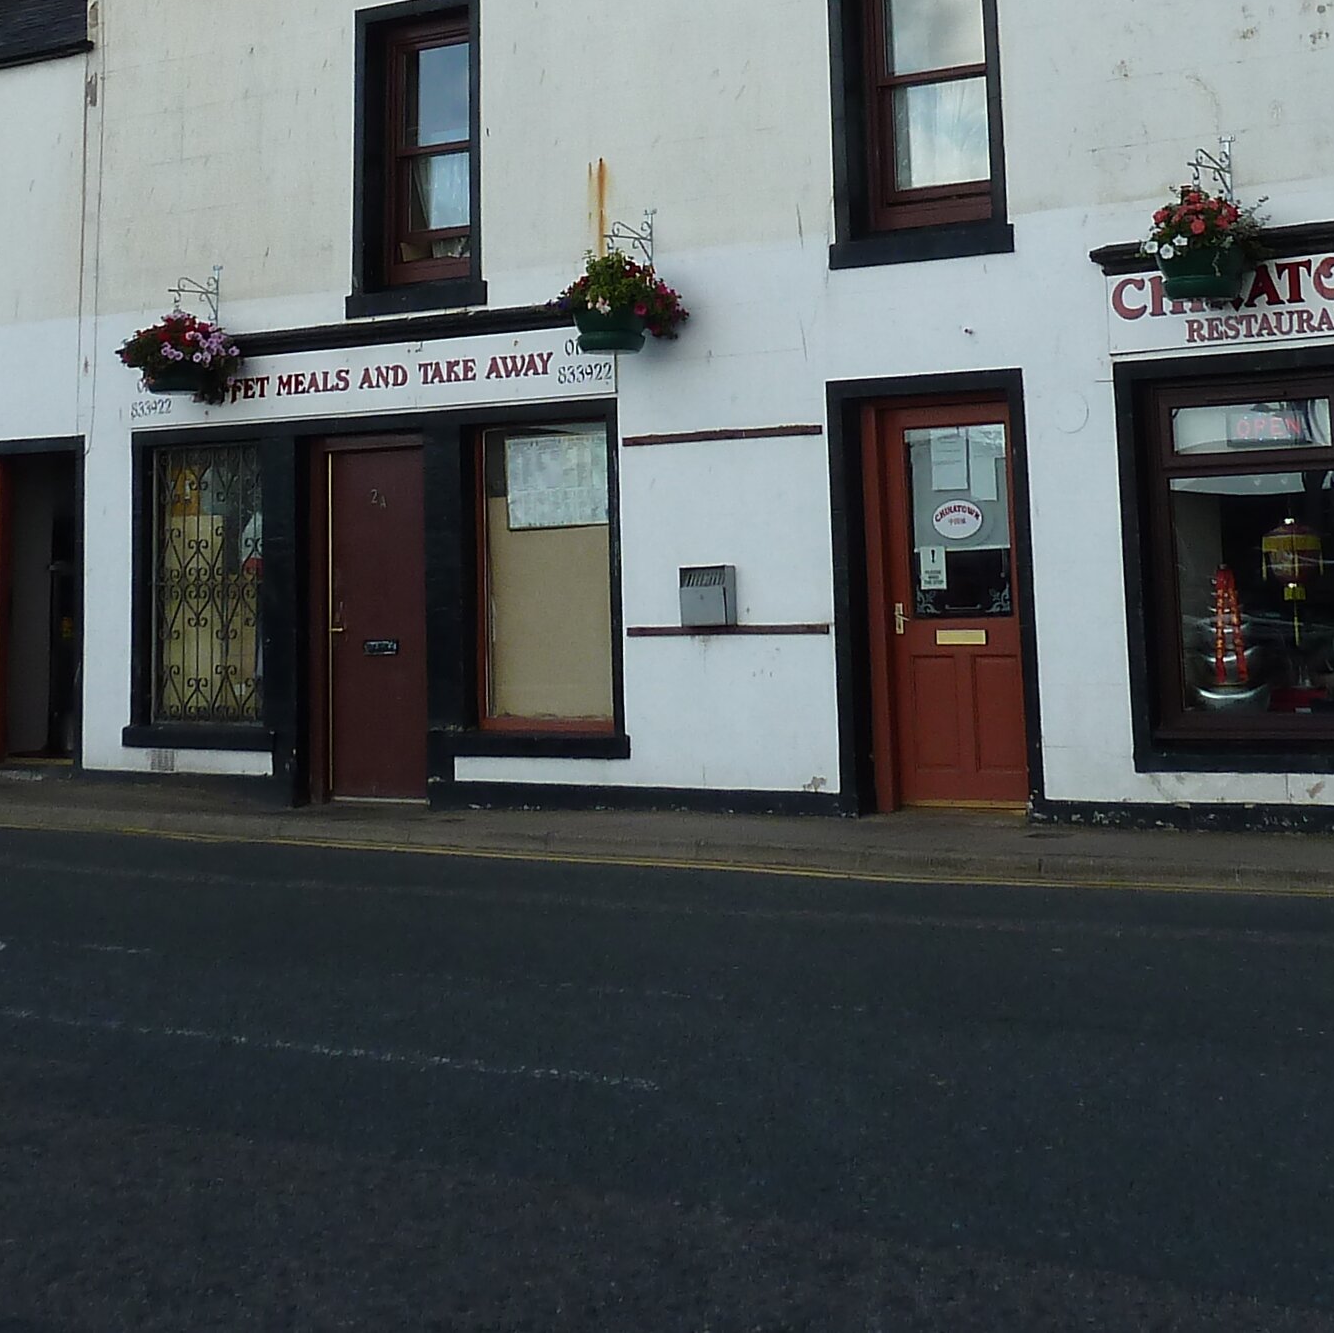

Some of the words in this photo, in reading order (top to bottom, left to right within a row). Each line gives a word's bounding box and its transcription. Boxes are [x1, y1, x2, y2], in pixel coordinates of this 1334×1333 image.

[276, 369, 350, 396] MEALS
[358, 364, 409, 390] AND
[418, 358, 477, 385] TAKE
[485, 351, 554, 380] AWAY
[558, 362, 612, 385] 833922
[1236, 416, 1301, 437] OPEN
[934, 504, 980, 522] CHINATOWN
